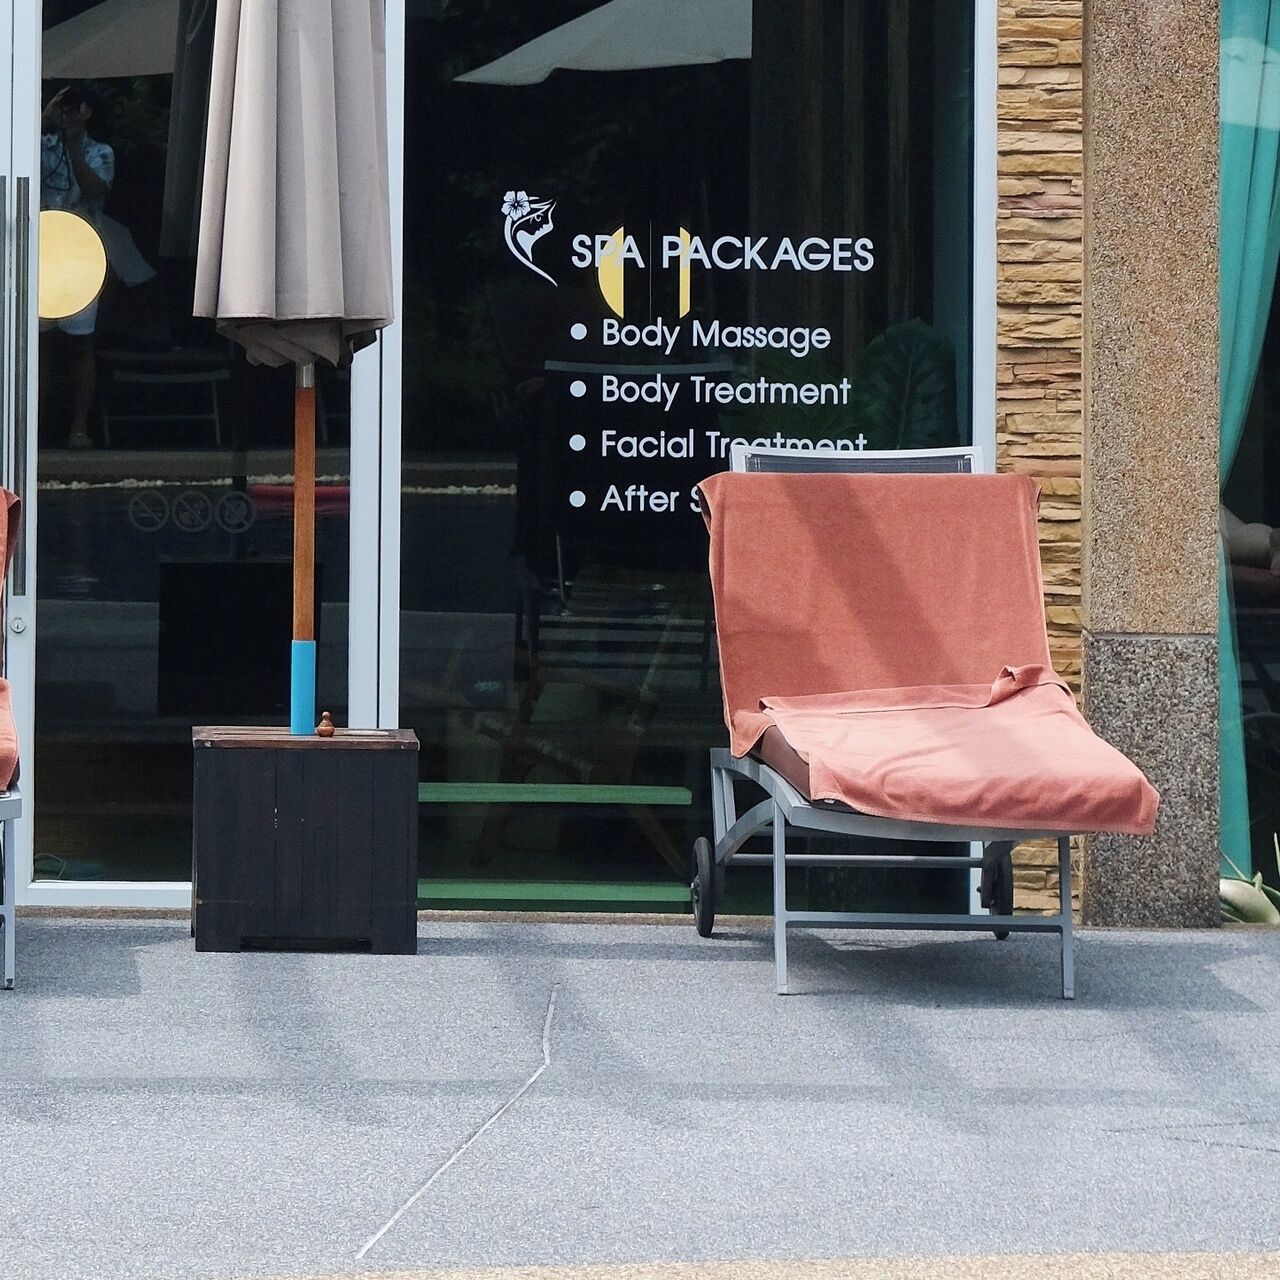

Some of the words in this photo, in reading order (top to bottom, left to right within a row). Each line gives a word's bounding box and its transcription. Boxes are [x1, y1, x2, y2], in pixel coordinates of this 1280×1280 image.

[571, 234, 646, 269] SPA
[662, 235, 875, 272] PACKAGES
[601, 317, 681, 355] Body
[692, 318, 832, 358] Massage
[601, 373, 681, 412] Body
[690, 375, 852, 406] Treatment
[601, 428, 694, 458] Facial
[600, 484, 680, 513] After
